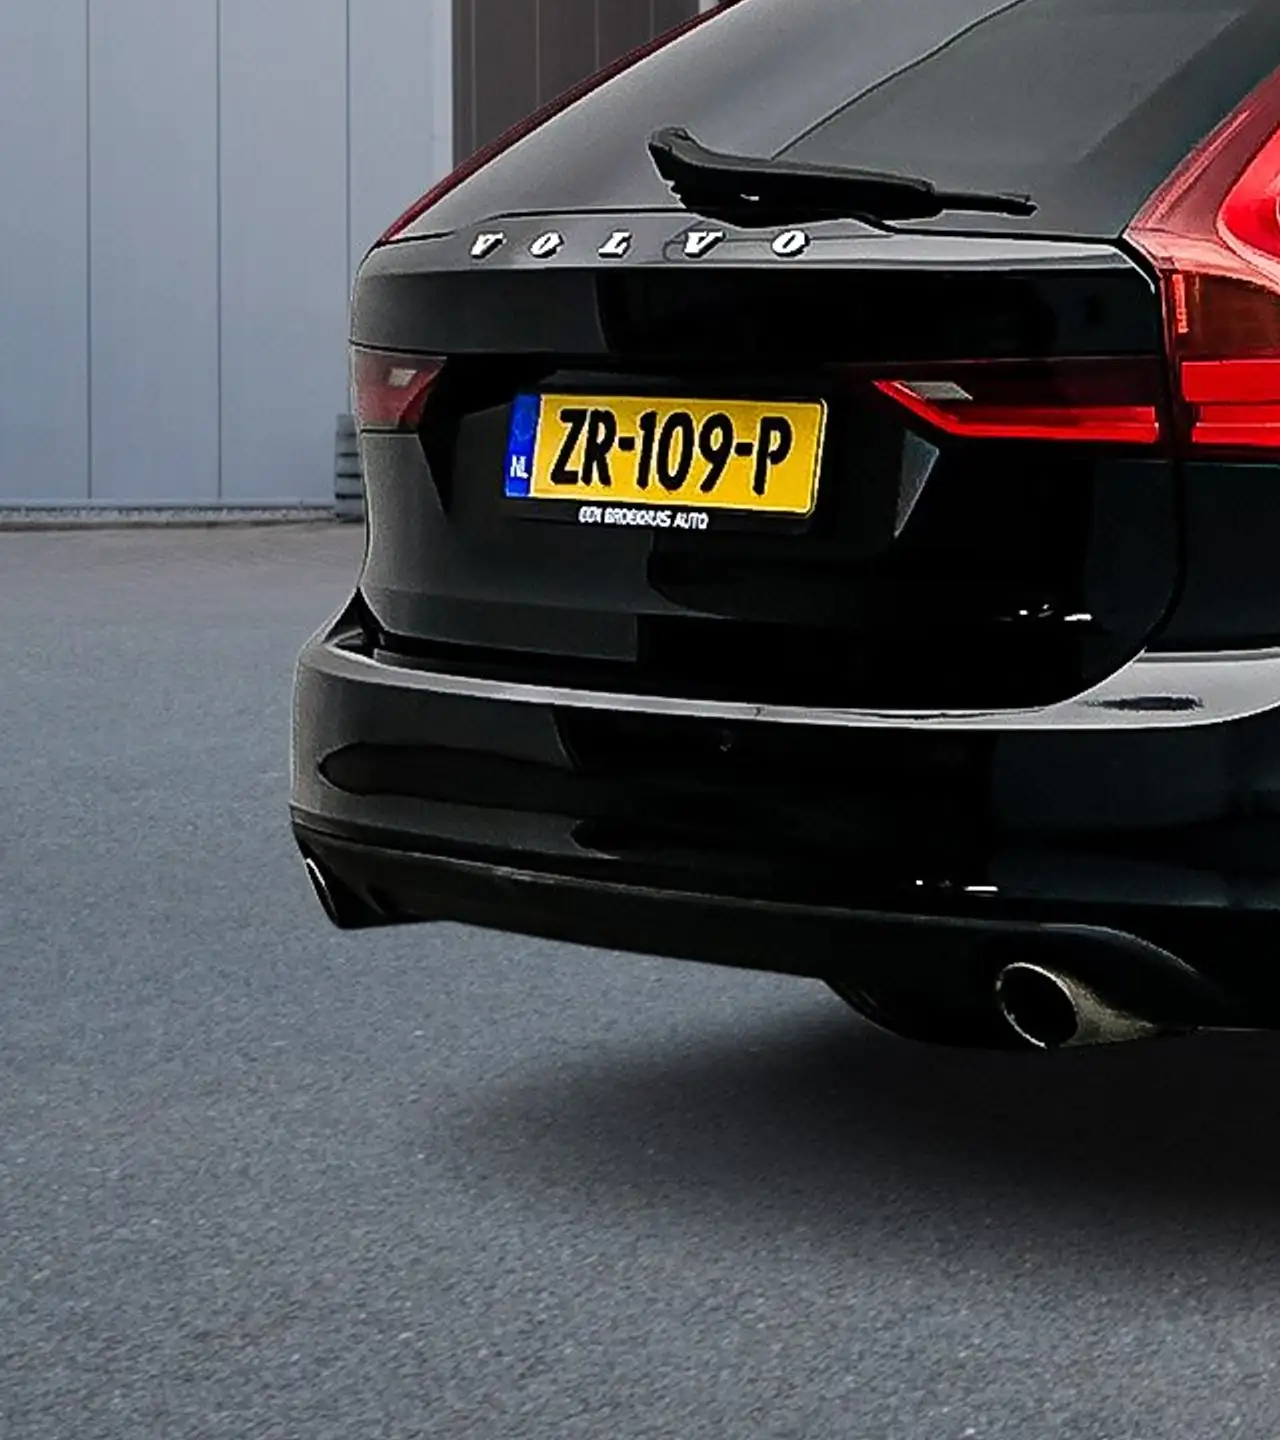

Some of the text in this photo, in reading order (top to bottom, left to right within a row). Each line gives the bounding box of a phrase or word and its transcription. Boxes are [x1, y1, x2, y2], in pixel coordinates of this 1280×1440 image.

[468, 229, 811, 259] VOLVO
[510, 407, 793, 496] NL ZR-109-P
[673, 512, 709, 529] AUTO
